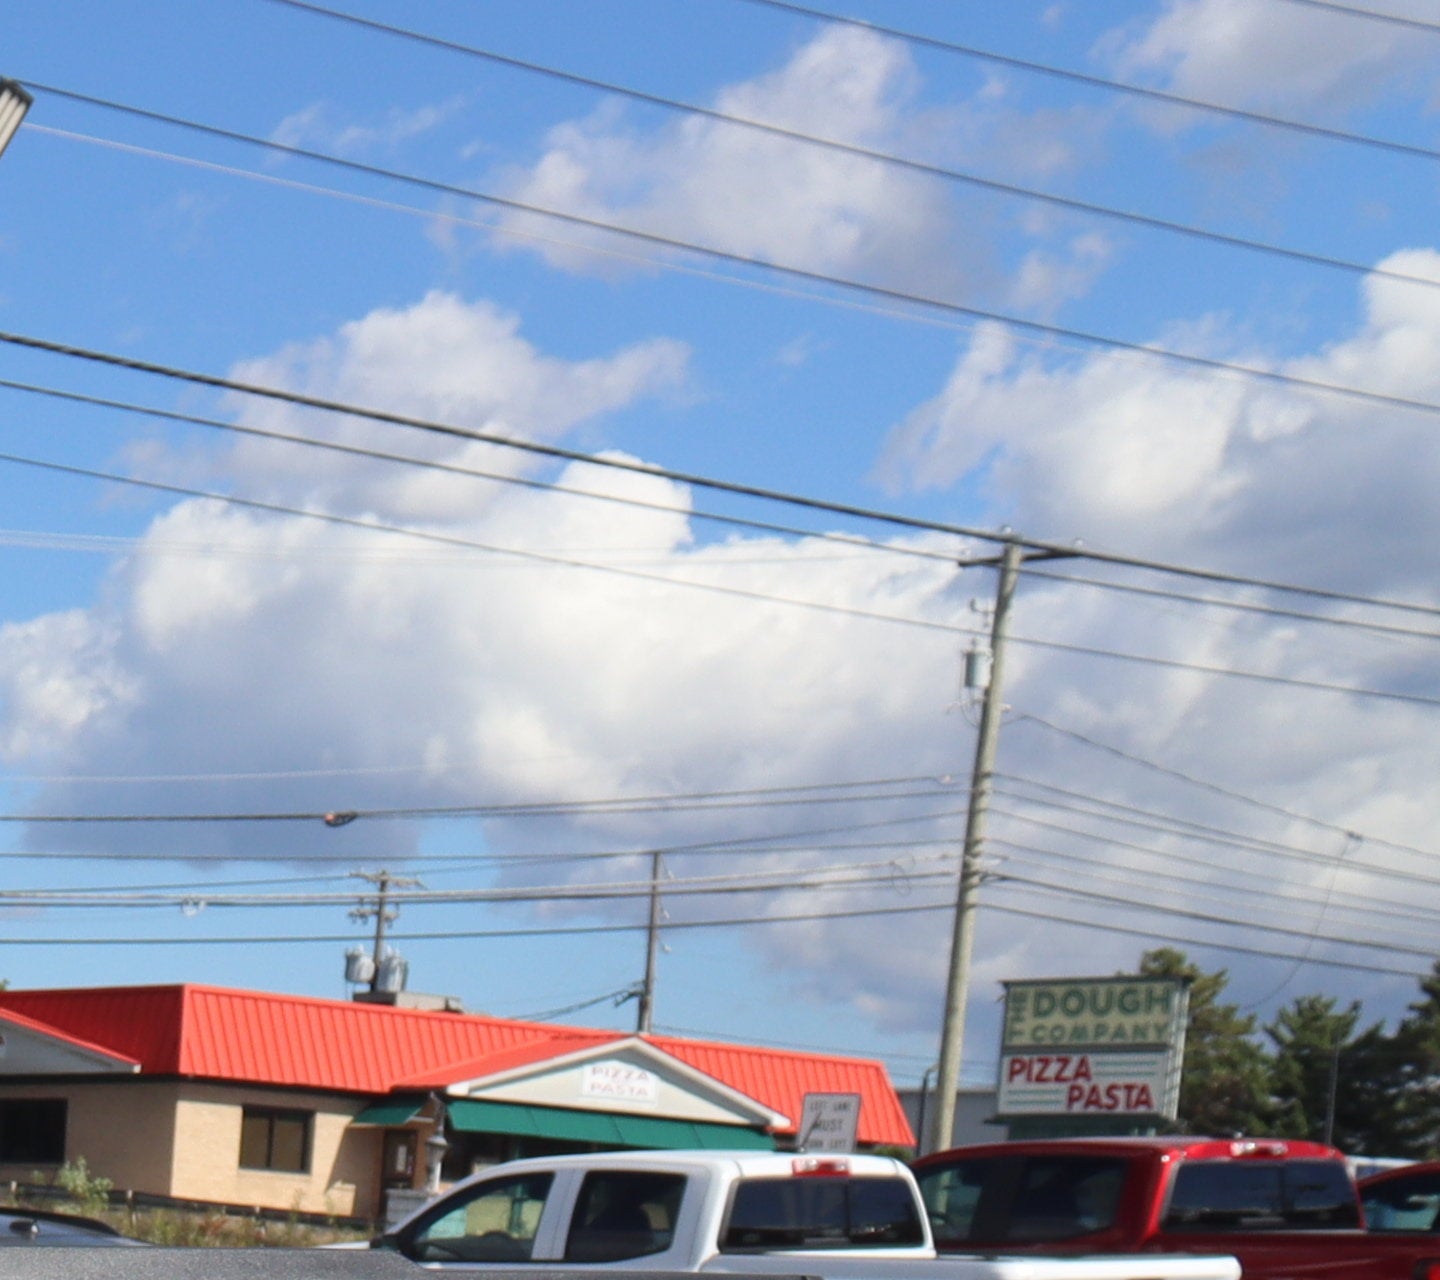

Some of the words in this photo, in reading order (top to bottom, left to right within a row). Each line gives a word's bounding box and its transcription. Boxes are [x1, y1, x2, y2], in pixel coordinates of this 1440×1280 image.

[1034, 984, 1171, 1019] DOUGH
[1033, 1023, 1169, 1042] COMPANY
[1008, 1056, 1092, 1083] PIZZA
[1067, 1083, 1154, 1111] PASTA
